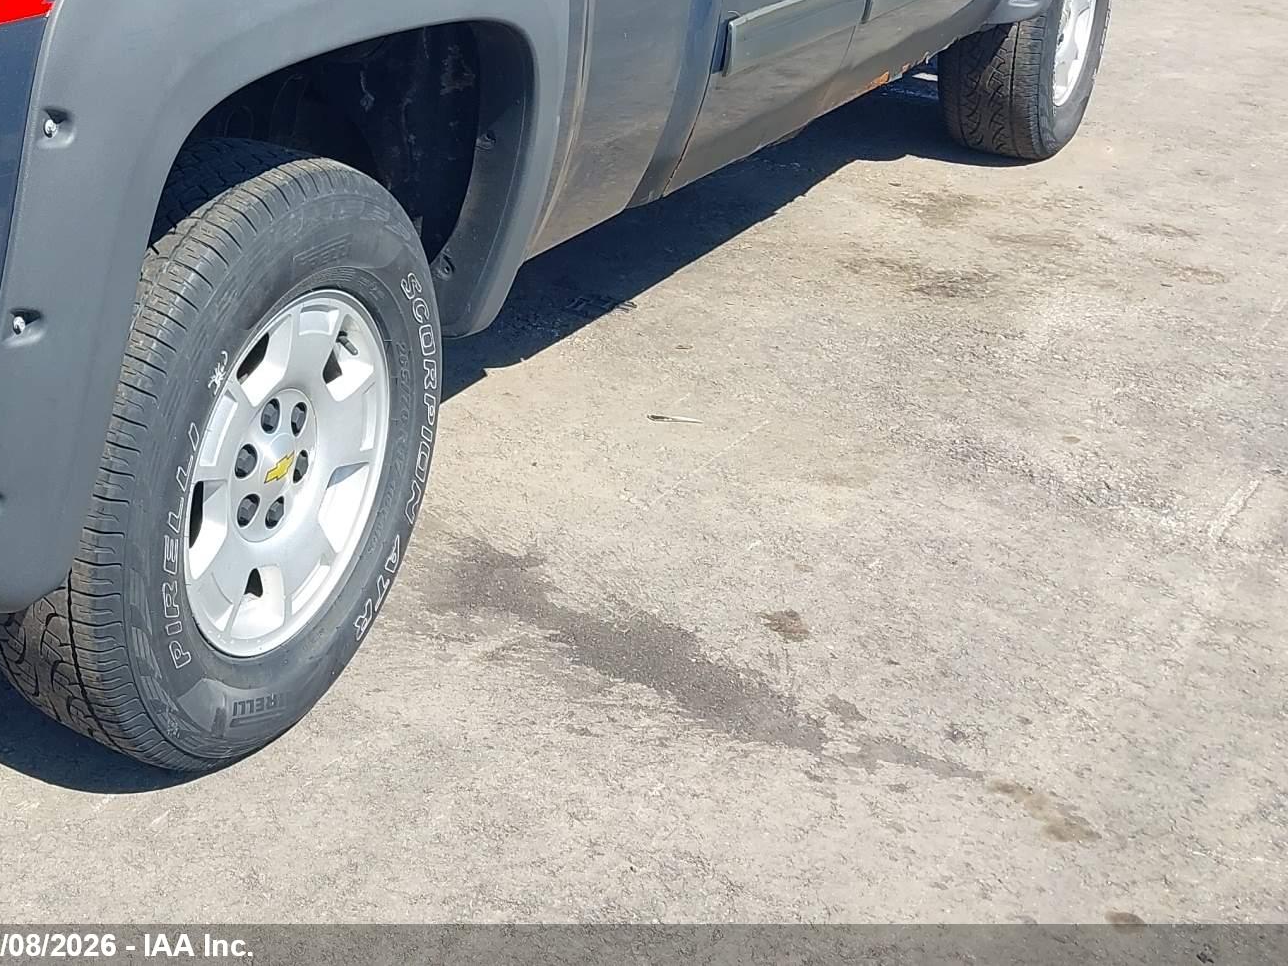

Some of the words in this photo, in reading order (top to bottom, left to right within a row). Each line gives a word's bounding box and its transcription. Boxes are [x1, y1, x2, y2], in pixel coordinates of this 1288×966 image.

[400, 272, 437, 525] SCORPION
[162, 422, 199, 669] PIRELLI
[355, 533, 400, 642] ATR
